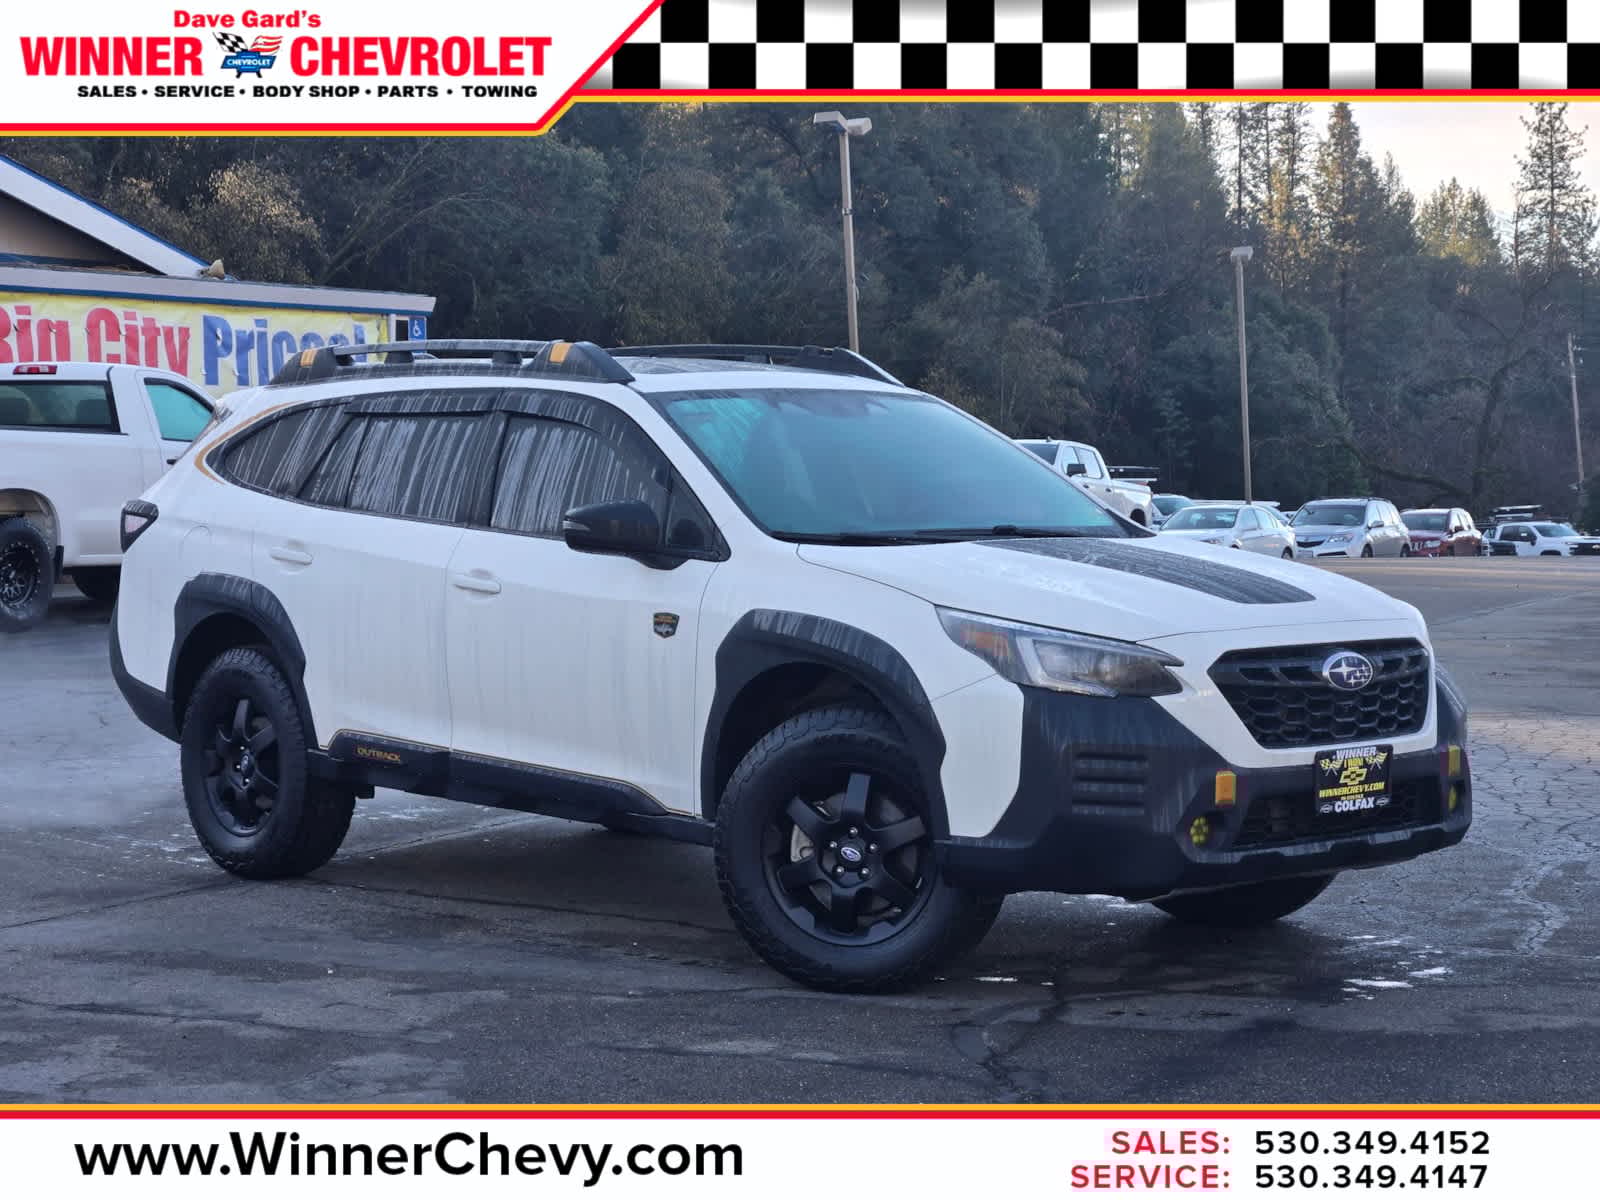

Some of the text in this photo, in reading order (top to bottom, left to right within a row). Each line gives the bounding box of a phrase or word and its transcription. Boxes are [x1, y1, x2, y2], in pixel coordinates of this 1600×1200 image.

[86, 307, 191, 377] City
[356, 747, 402, 763] OUTBACK
[1336, 746, 1377, 761] WINNER
[1319, 782, 1385, 798] WINNERCHEVY.COM
[1334, 797, 1375, 812] COLFAX
